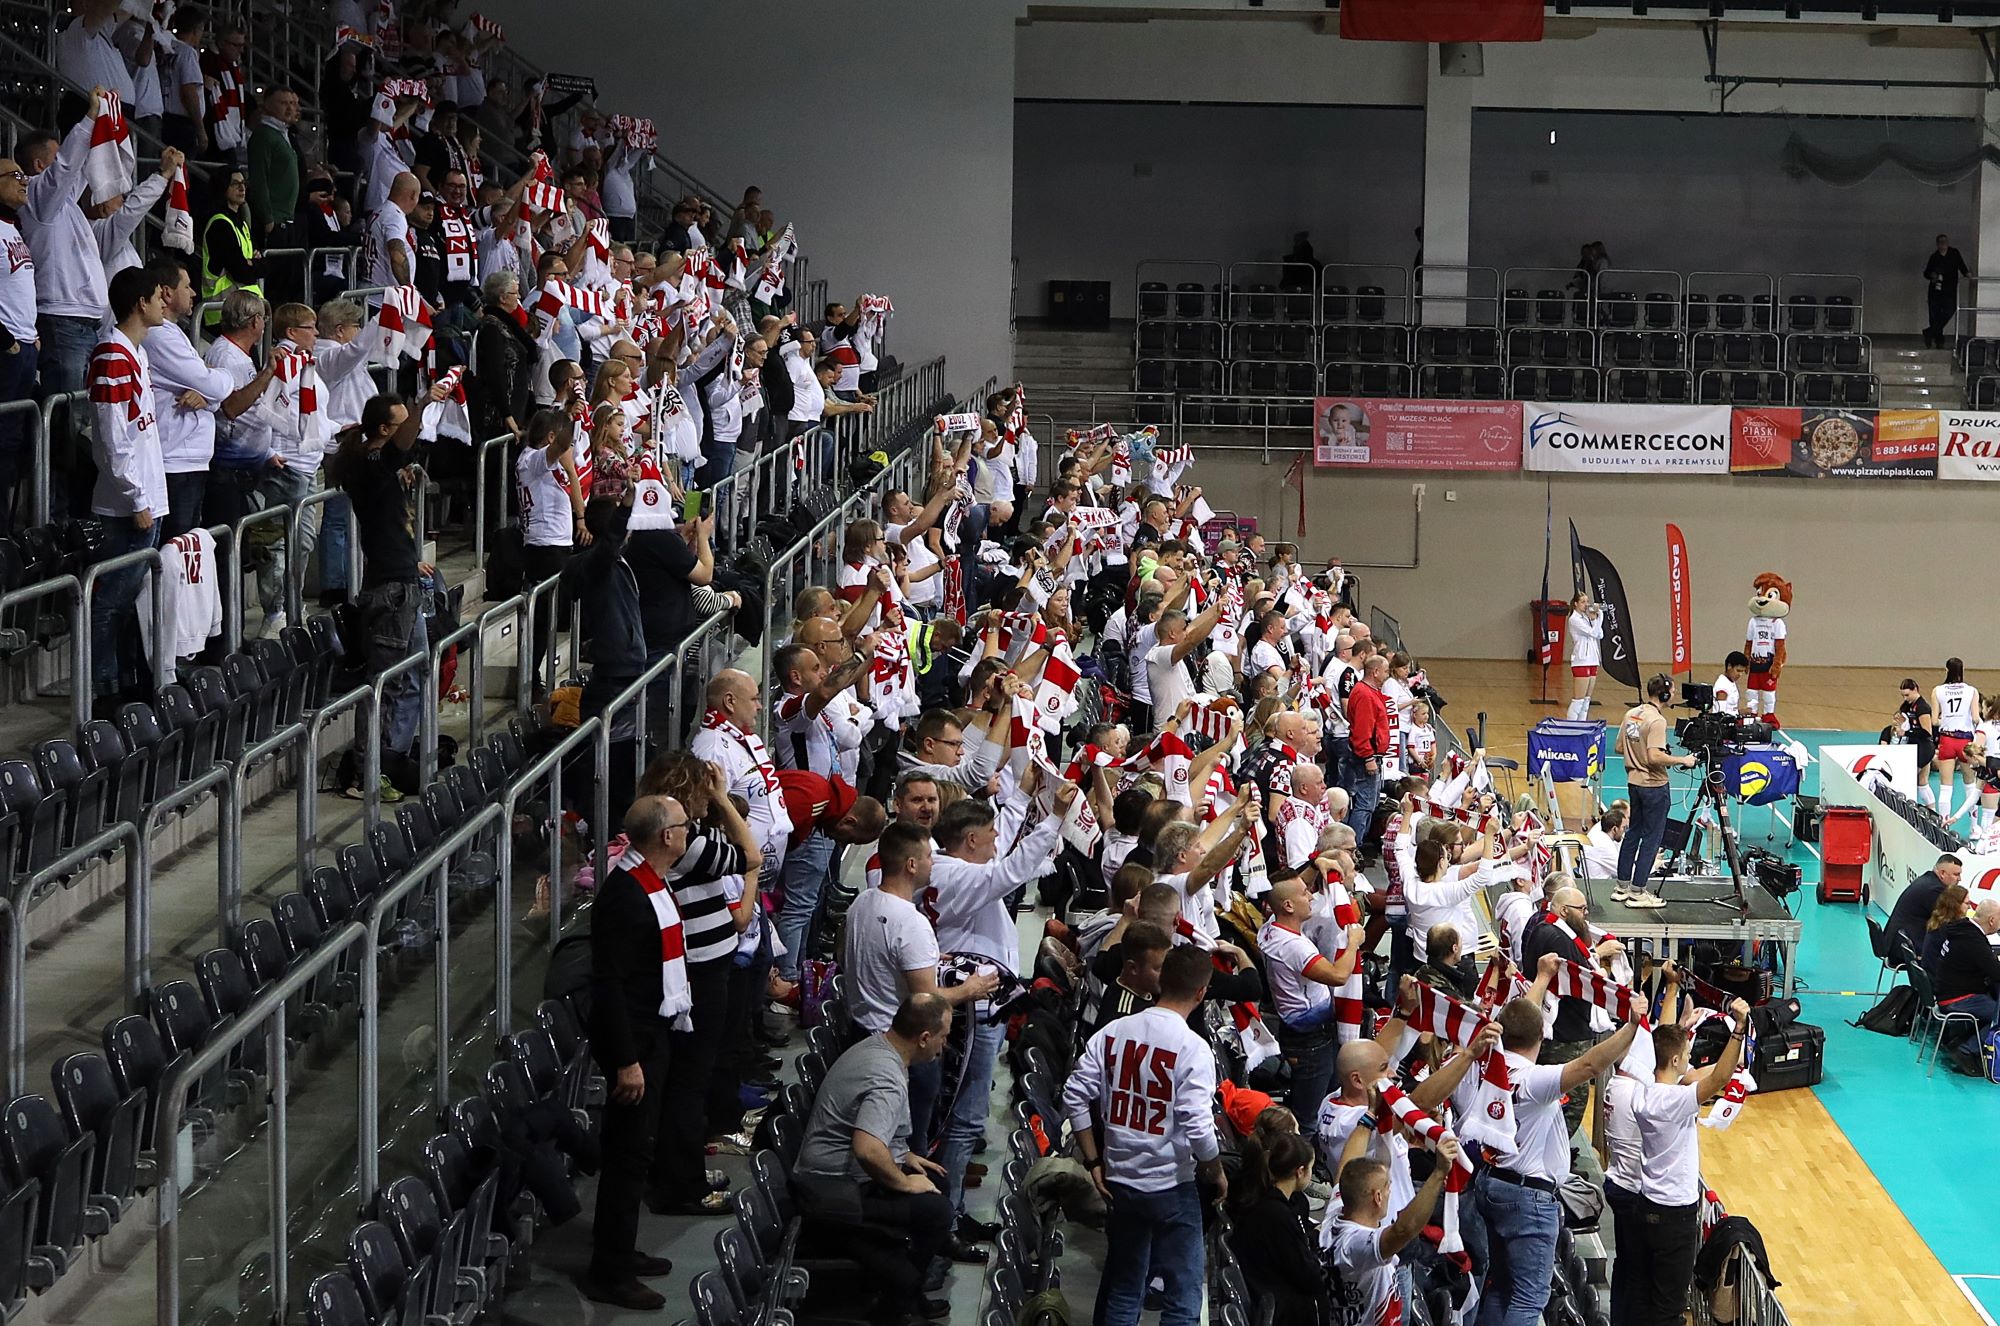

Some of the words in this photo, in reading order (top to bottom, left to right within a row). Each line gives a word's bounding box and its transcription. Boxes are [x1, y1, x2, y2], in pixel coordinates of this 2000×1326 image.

[1742, 426, 1777, 436] PIASKI
[1548, 432, 1724, 451] COMMERCECON
[1883, 446, 1899, 455] 883
[1902, 444, 1917, 453] 445
[1919, 443, 1936, 452] 442
[1582, 457, 1636, 465] BUDUJEMY
[1666, 458, 1724, 466] PRZEMYSŁU
[1831, 467, 1934, 478] www.pizzeriapiaski.com
[1946, 697, 1962, 713] 17
[1423, 741, 1430, 749] 13
[1105, 1034, 1178, 1102] ŁKS
